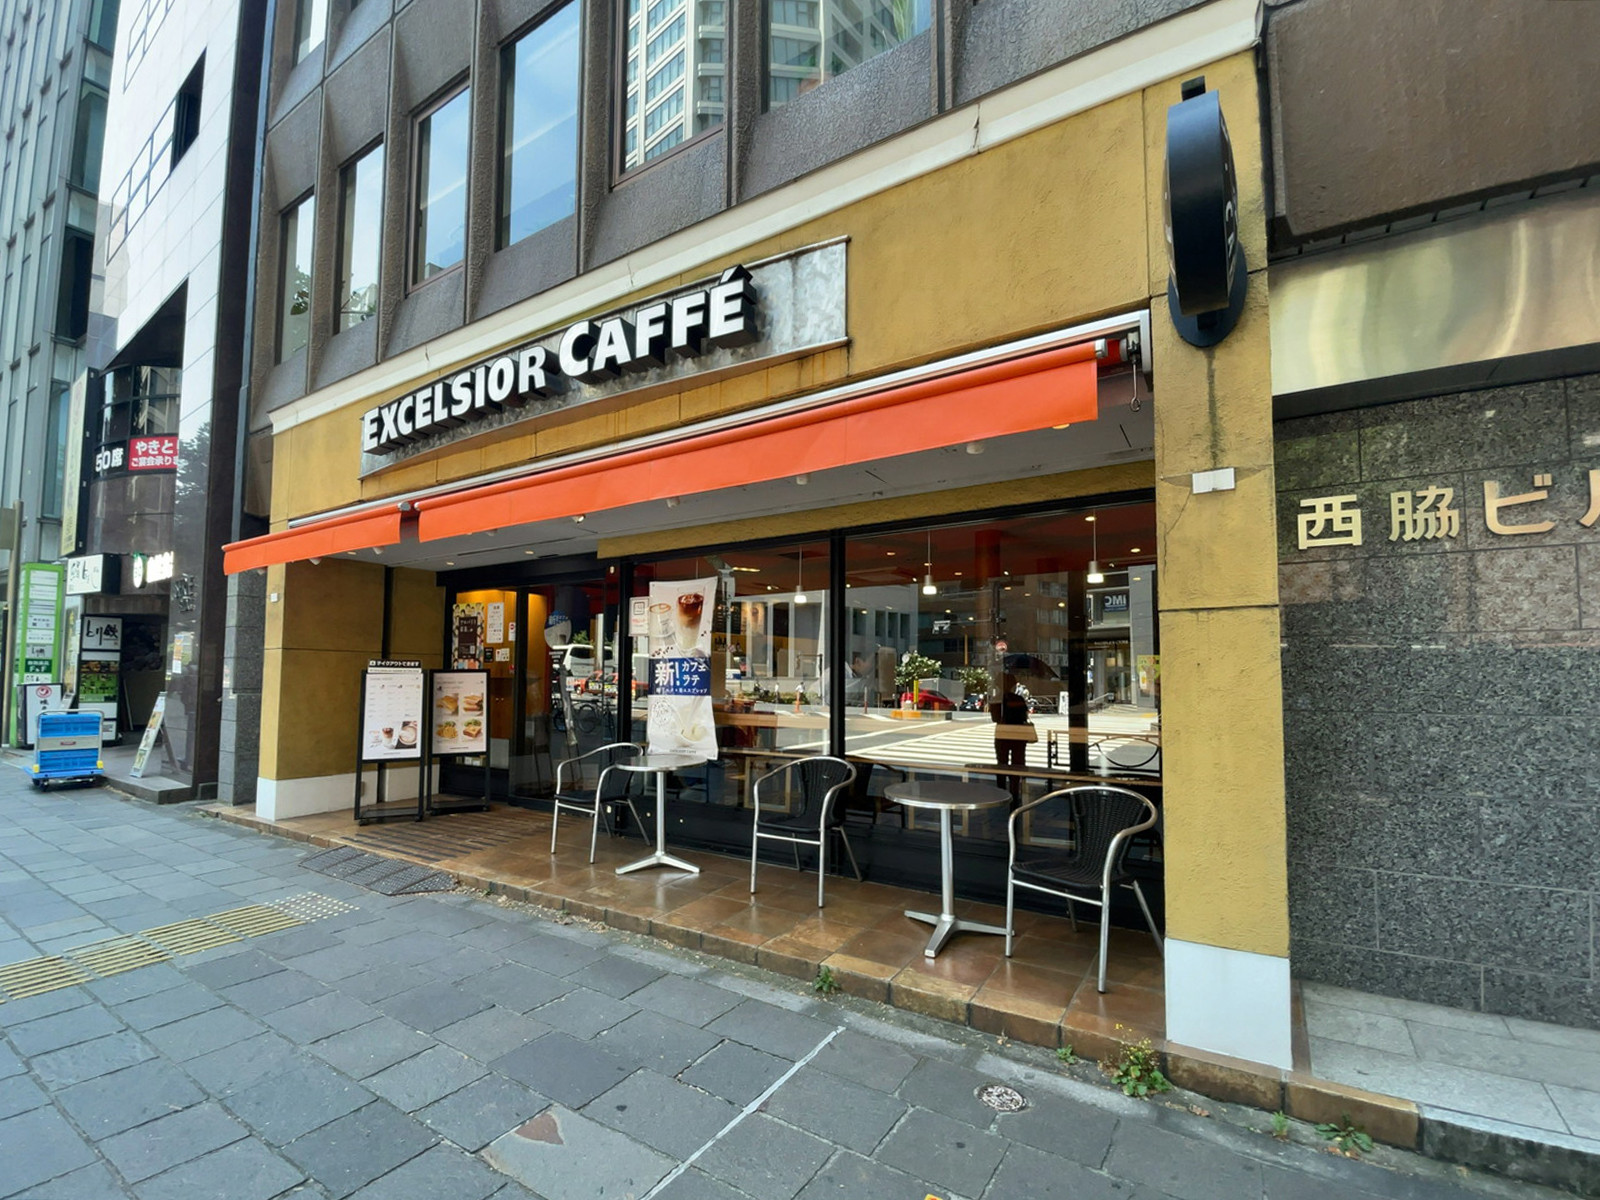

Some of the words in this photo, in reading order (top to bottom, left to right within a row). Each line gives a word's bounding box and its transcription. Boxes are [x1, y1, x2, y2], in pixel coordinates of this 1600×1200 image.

[363, 345, 547, 452] EXCELSIOR
[558, 264, 750, 380] CAFFÉ
[135, 439, 179, 456] やきと
[95, 448, 124, 472] 50席
[654, 661, 681, 686] 新!
[681, 661, 707, 672] カフェ
[682, 674, 701, 686] ラテ
